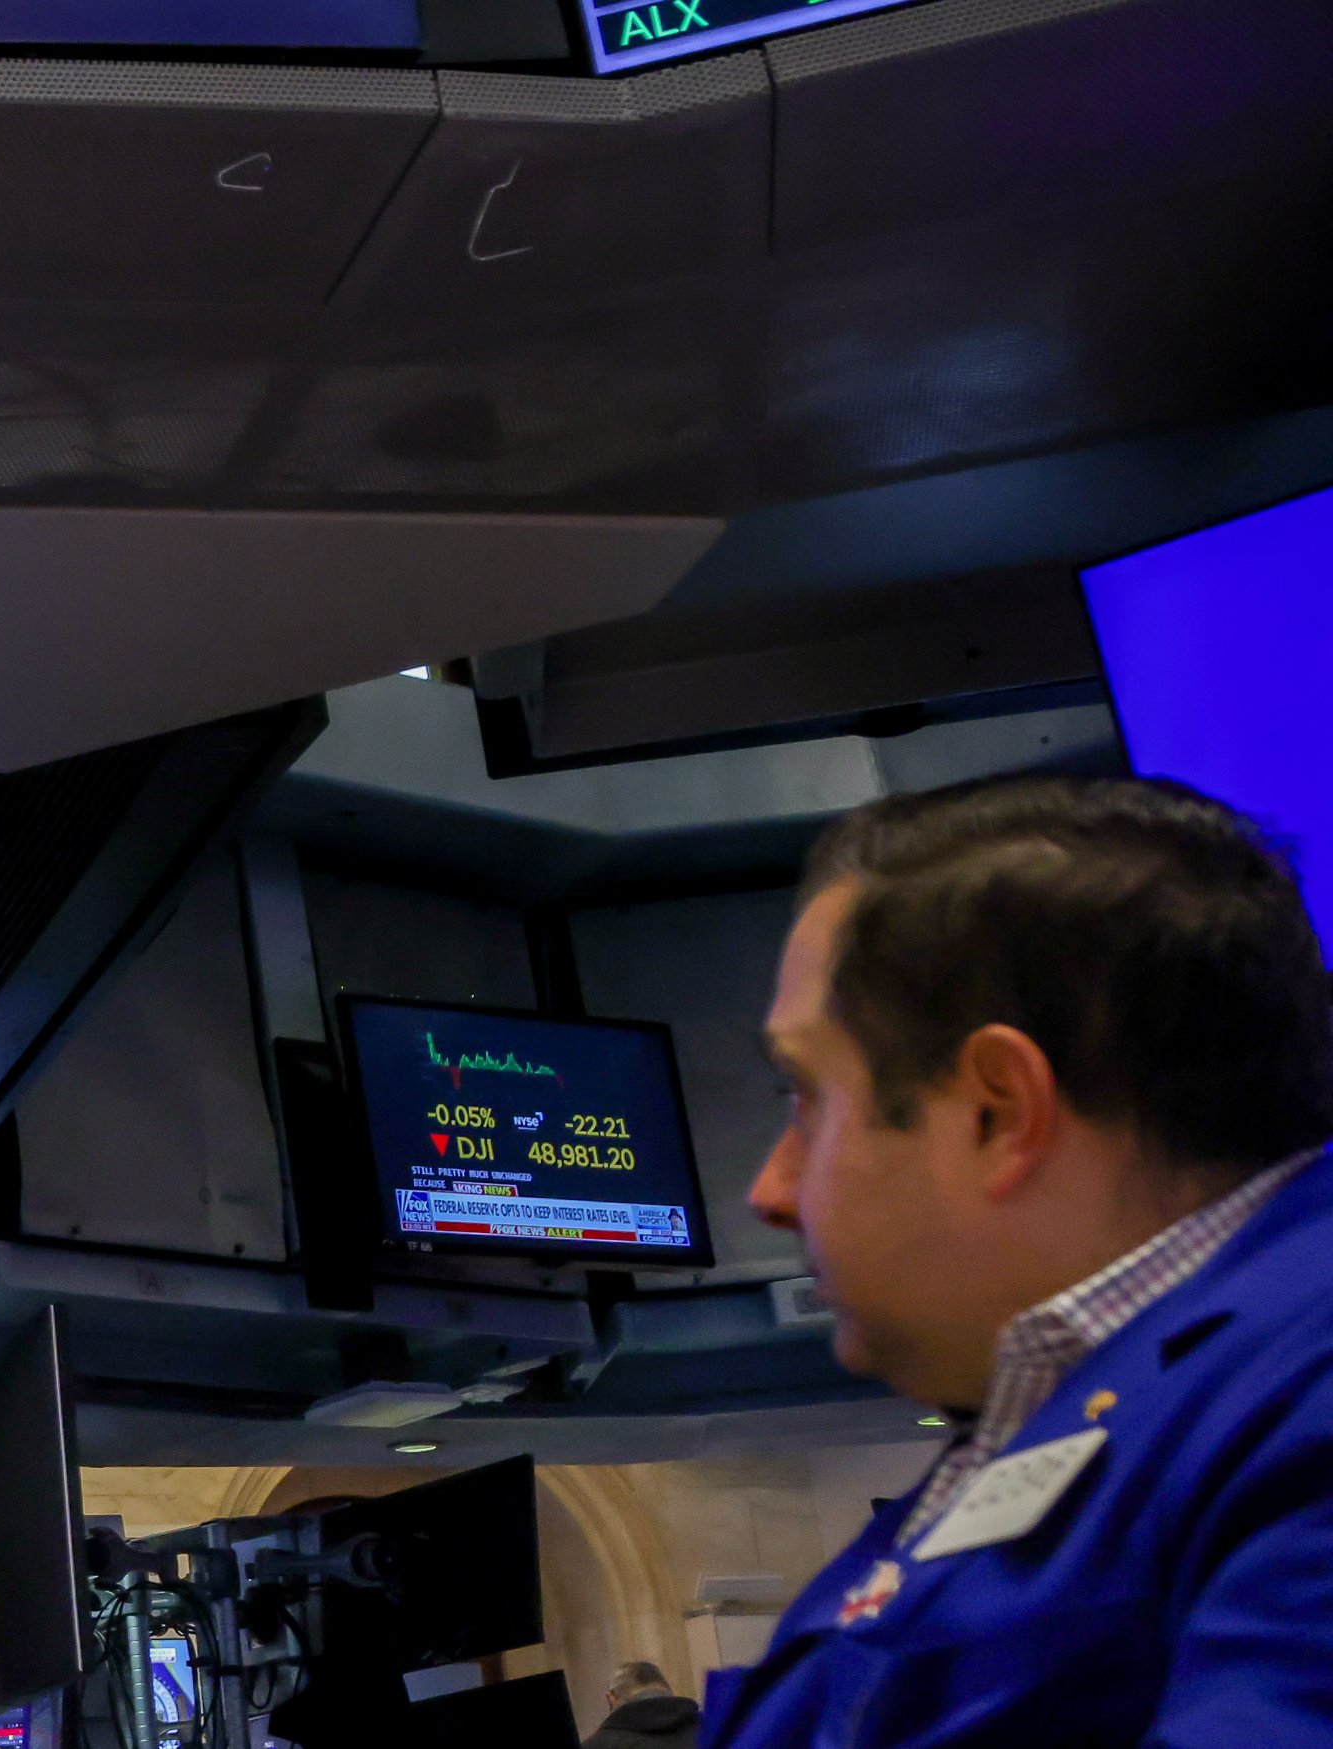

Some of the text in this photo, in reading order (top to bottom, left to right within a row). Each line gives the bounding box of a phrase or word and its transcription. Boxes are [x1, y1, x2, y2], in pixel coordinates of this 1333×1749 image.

[619, 0, 709, 46] ALX
[427, 1103, 496, 1129] -0.05%
[565, 1114, 630, 1138] -22.21
[457, 1136, 635, 1170] DJI 48,981.20
[412, 1165, 434, 1176] STILL
[438, 1167, 465, 1178] PRETTY
[483, 1185, 512, 1196] NEWS
[408, 1199, 429, 1211] FOX
[405, 1211, 431, 1222] NEWS
[434, 1200, 466, 1214] FEDERAL
[467, 1202, 499, 1216] RESERVE
[501, 1204, 520, 1217] OPTS
[521, 1205, 532, 1218] TO
[533, 1205, 551, 1219] KEEP
[586, 1209, 609, 1223] RATES
[610, 1210, 631, 1224] LEVEL
[495, 1225, 583, 1238] FOX NEWS ALERT
